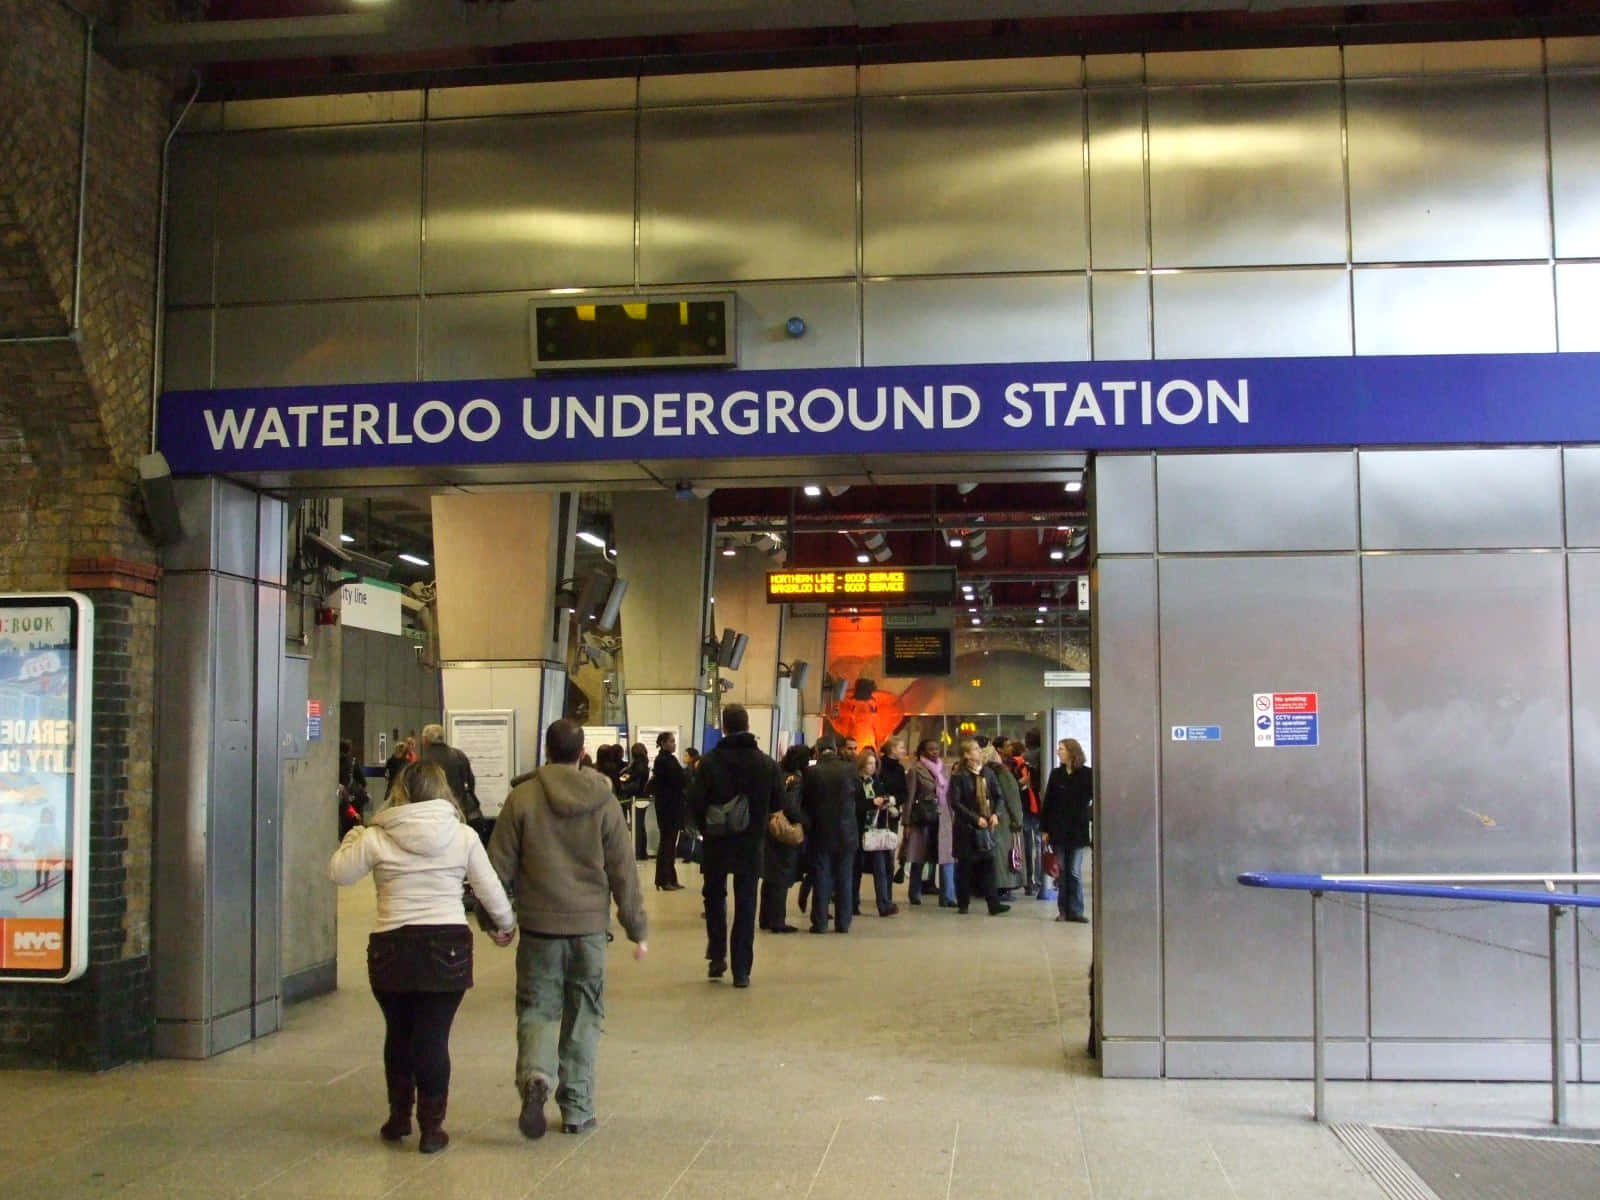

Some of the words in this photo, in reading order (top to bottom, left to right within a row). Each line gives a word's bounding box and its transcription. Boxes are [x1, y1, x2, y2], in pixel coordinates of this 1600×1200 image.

[203, 398, 501, 450] WATERLOO
[522, 385, 981, 440] UNDERGROUND
[1003, 379, 1249, 428] STATION
[354, 586, 368, 605] line
[13, 931, 62, 951] NYC
